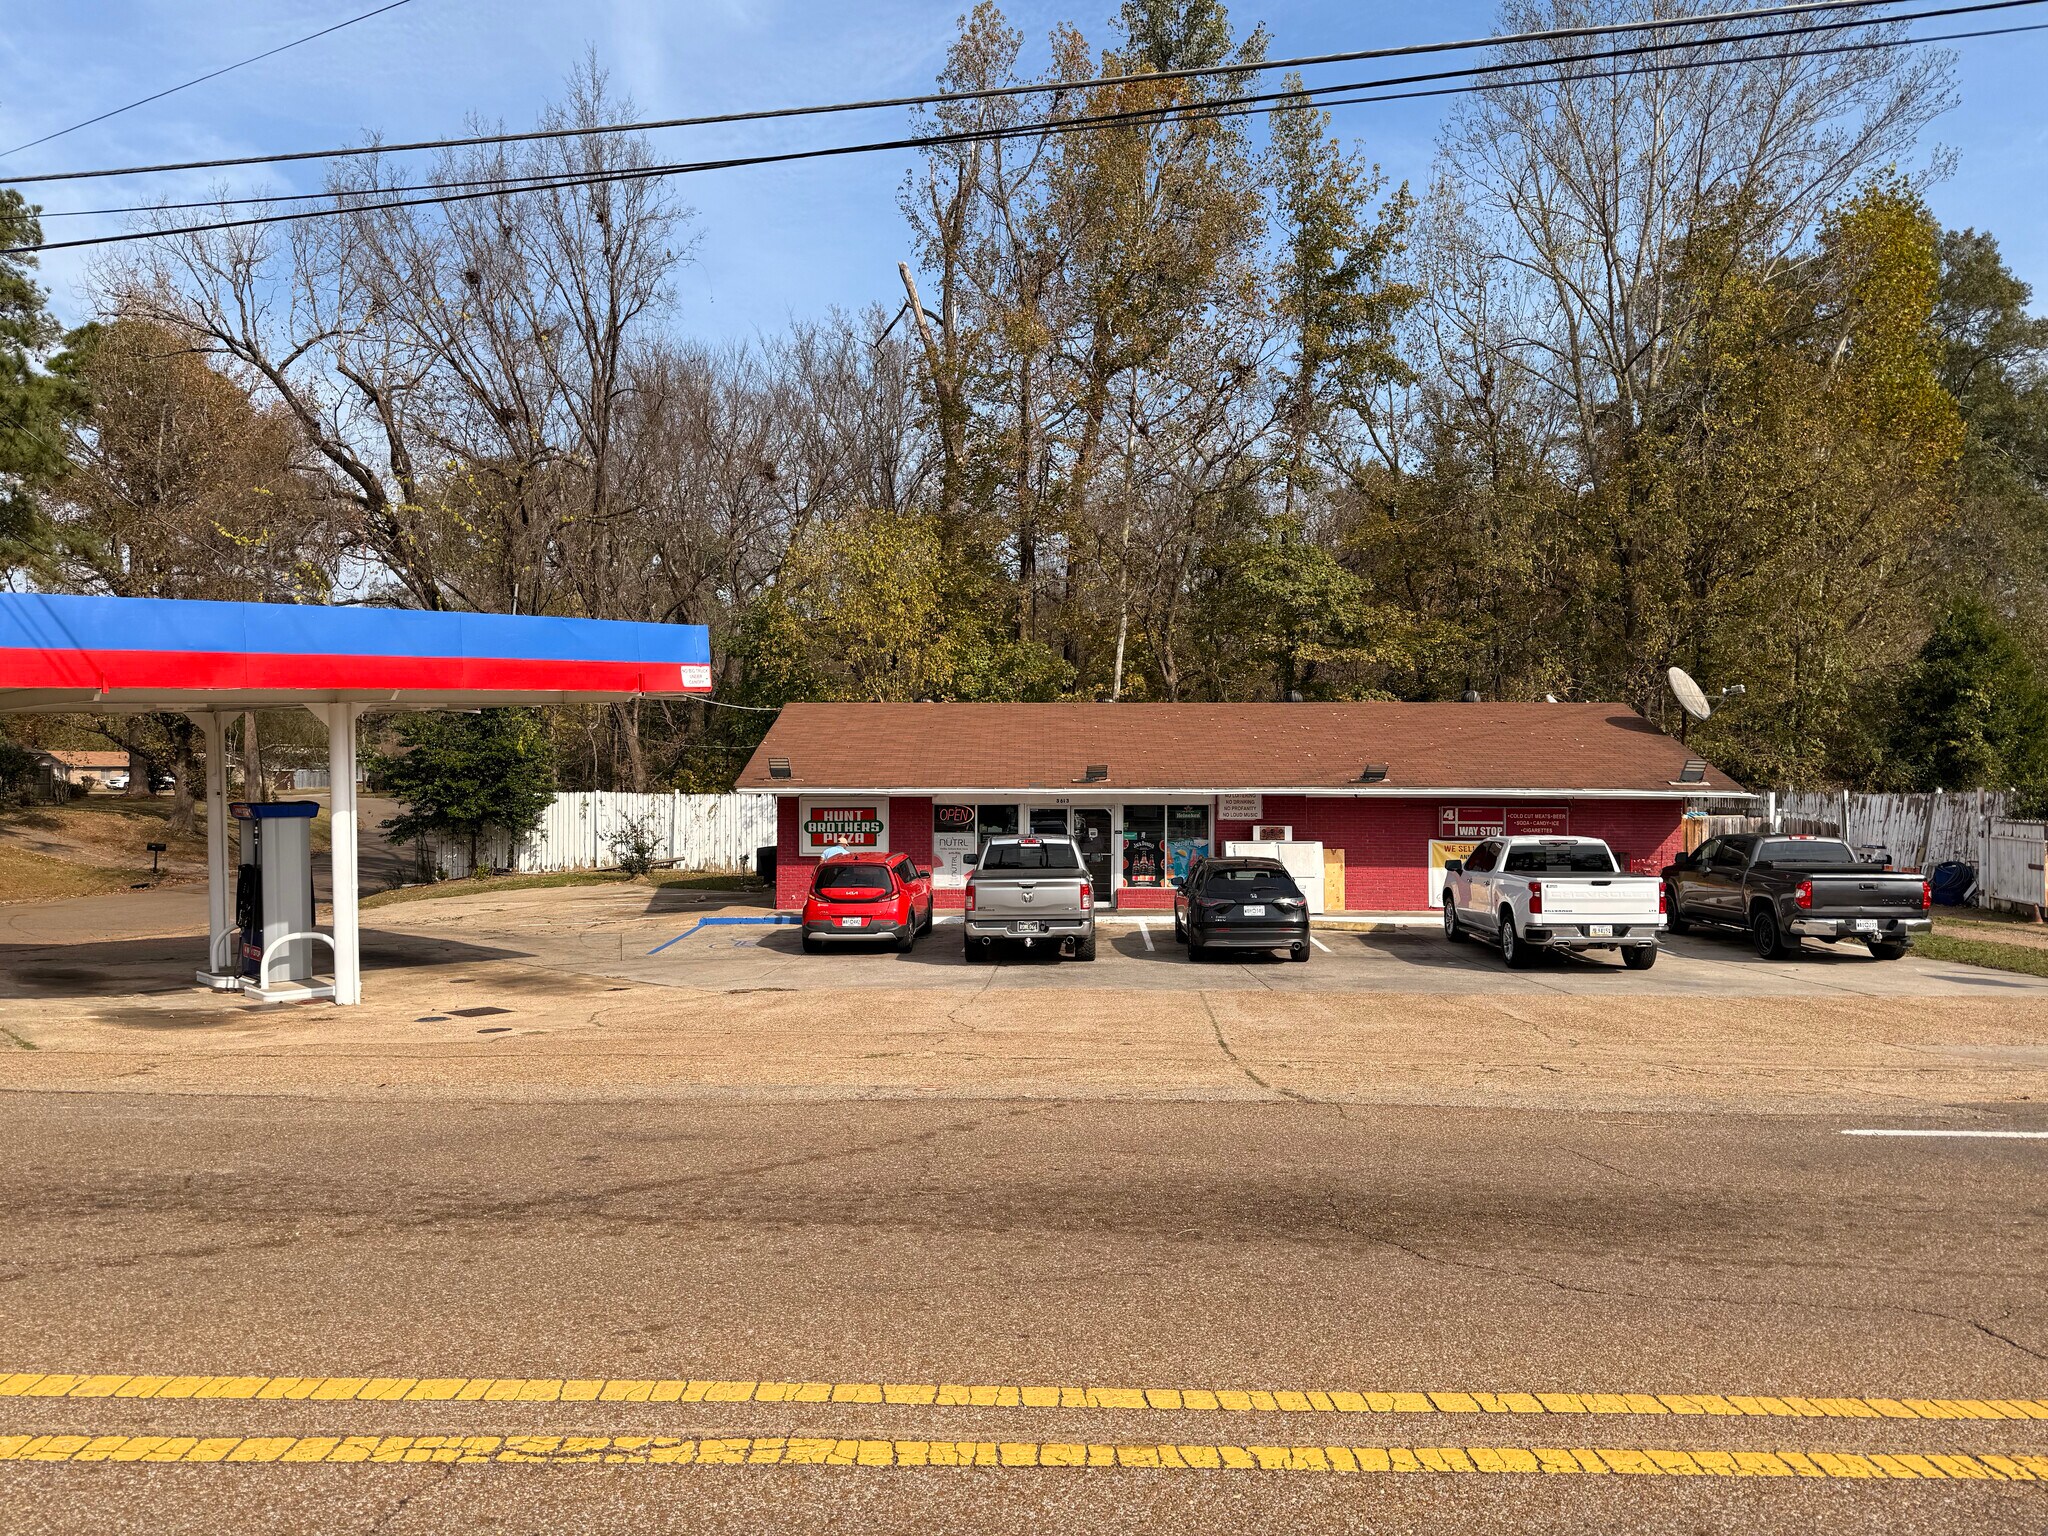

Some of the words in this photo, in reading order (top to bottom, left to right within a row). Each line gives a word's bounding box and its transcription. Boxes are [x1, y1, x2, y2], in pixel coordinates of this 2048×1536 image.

[823, 811, 863, 822] HUNT
[940, 808, 969, 821] OPEN
[1443, 810, 1454, 820] 4
[808, 822, 880, 832] BROTHERS
[1459, 826, 1479, 836] WAY
[1480, 826, 1503, 836] STOP
[823, 833, 865, 844] PIZZA
[1443, 845, 1456, 853] WE
